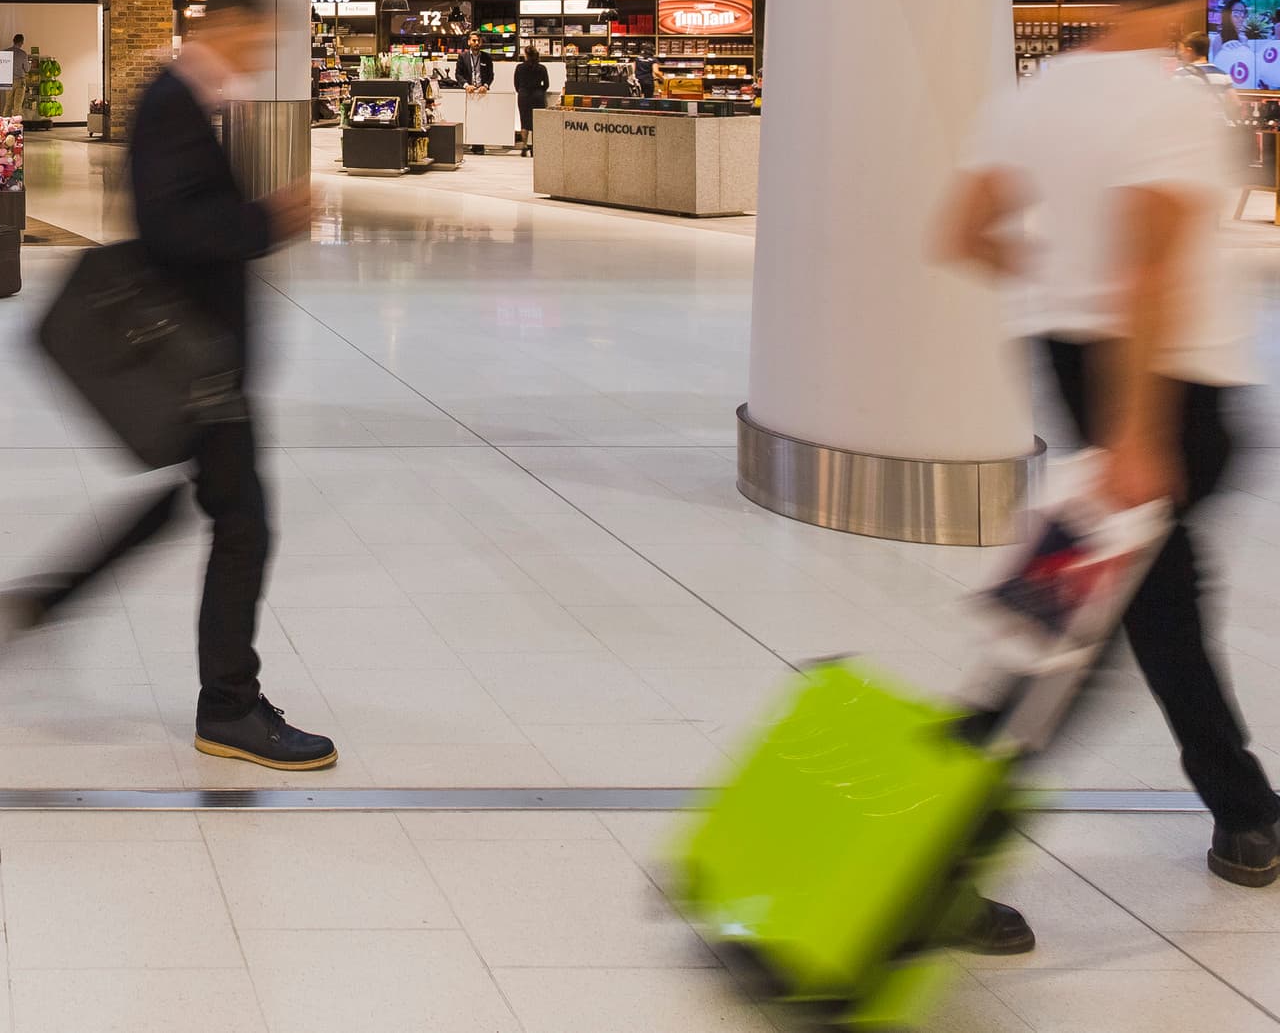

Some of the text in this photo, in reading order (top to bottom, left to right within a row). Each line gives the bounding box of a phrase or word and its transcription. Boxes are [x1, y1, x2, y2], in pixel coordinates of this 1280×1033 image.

[419, 10, 442, 26] T2
[564, 120, 656, 136] PANA CHOCOLATE
